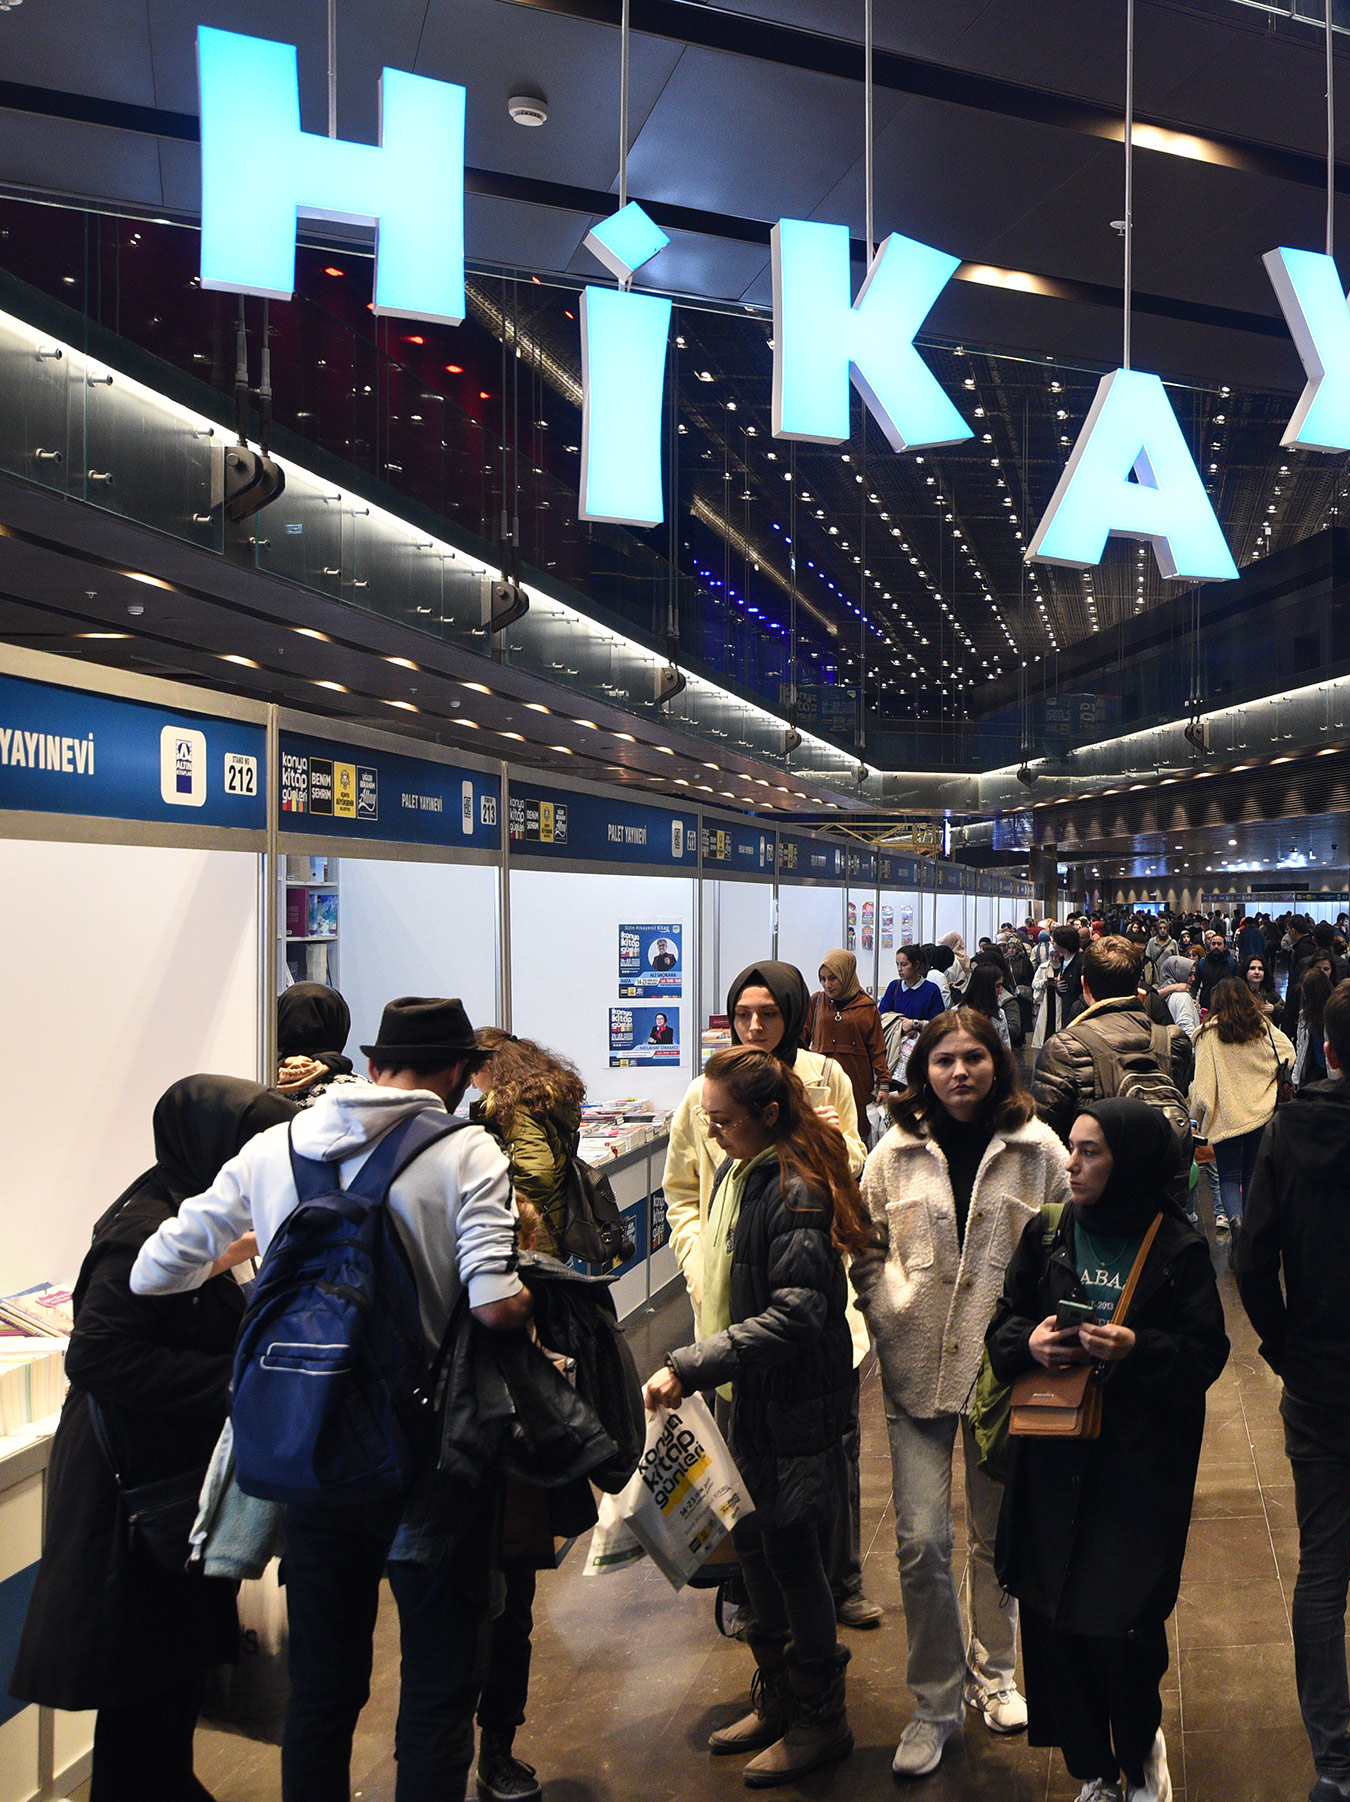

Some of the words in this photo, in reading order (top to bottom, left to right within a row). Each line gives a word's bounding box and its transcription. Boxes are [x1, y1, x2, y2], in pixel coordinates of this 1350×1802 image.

[0, 728, 94, 775] YAYINEVİ
[232, 755, 243, 764] STAND
[282, 752, 308, 773] konya
[228, 765, 253, 793] 212
[282, 767, 308, 791] kitap
[311, 772, 331, 787] BENİM
[282, 787, 308, 803] günleri
[311, 787, 331, 800] ŞEHRİM
[401, 792, 419, 809] PALET
[419, 795, 443, 812] YAYINEVİ
[482, 803, 496, 824] 213
[607, 823, 624, 843] PALET
[625, 825, 647, 845] YAYINEVİ
[1080, 1268, 1126, 1291] ABA
[638, 1413, 684, 1476] konya
[642, 1430, 695, 1493] kitap
[654, 1441, 705, 1510] günleri
